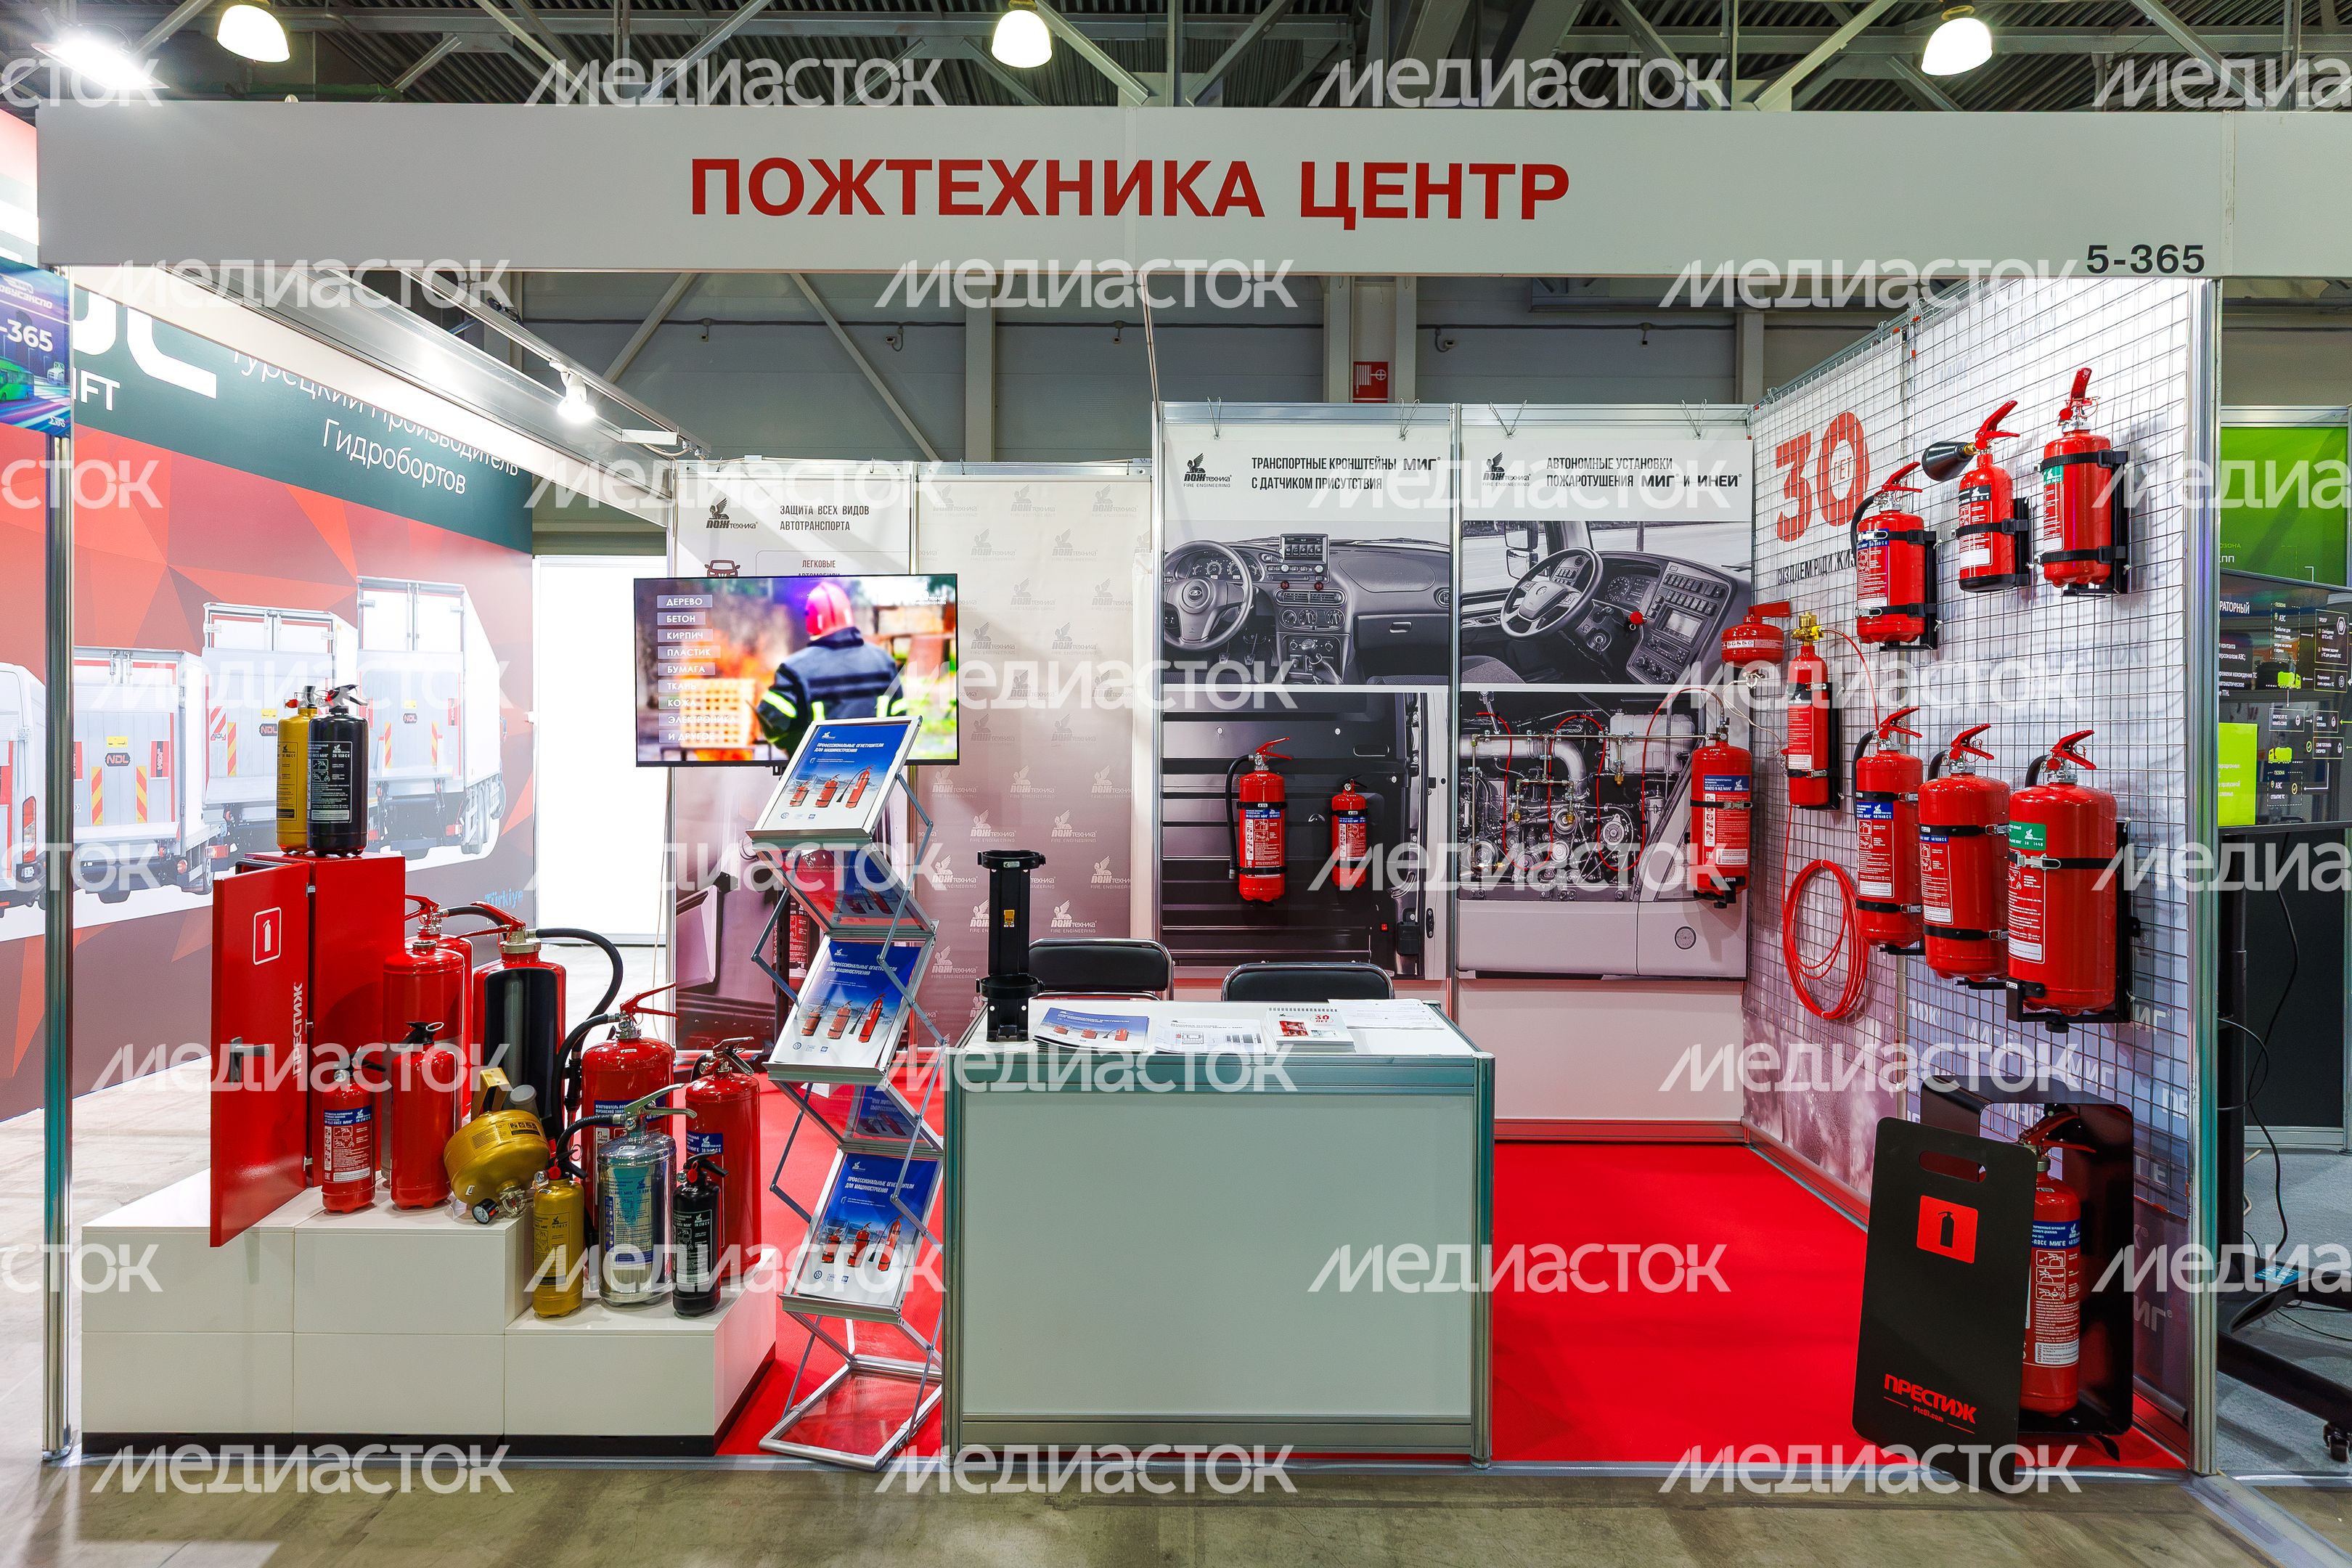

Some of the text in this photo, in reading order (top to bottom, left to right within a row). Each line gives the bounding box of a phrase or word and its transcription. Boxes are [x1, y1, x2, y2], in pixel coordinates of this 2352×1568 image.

[692, 157, 1571, 231] ПОЖТЕХНИКА ЦЕНТР
[2086, 244, 2205, 274] 5-365
[322, 417, 467, 495] Гидробортов
[1251, 457, 1328, 470] ТРАНСПОРТНЫЕ
[1330, 455, 1397, 470] КРОНШТЕЙНЫ
[1547, 457, 1673, 470] АВТОНОМНЫЕ УСТАНОВКИ
[1547, 475, 1634, 487] ПОЖАРОТУШЕНИЯ
[1776, 411, 1870, 542] 30
[1251, 478, 1382, 491] С ДАТЧИКОМ ПРИСУТСТВИЯ
[780, 505, 870, 516] ЗАЩИТА ВСЕХ ВИДОВ
[780, 520, 850, 531] АВТОТРАНСПОРТА
[801, 560, 836, 568] ЛЕГКОВЫЕ
[666, 597, 703, 608] ДЕРЕВО
[666, 614, 696, 624] БЕТОН
[666, 631, 703, 640] КИРПИЧ
[666, 648, 711, 657] ПЛАСТИК
[667, 664, 706, 674] БУМАГА
[667, 682, 696, 691] ТКАНЬ
[667, 698, 697, 708] КОЖА
[667, 715, 737, 724] ЭЛЕКТРОНИКА
[668, 732, 715, 742] И ДРУГОЕ
[106, 754, 129, 764] NDL
[830, 960, 868, 970] ПРОФЕССИОНАЛЬНЫЕ
[293, 981, 303, 1077] ПРЕСТИЖ
[847, 1176, 886, 1188] ПРОФЕССИОНАЛЬНЫЕ
[854, 1183, 888, 1193] МАШИНОСТРОЕНИЯ
[1884, 1373, 1977, 1424] ПРЕСТИЖ
